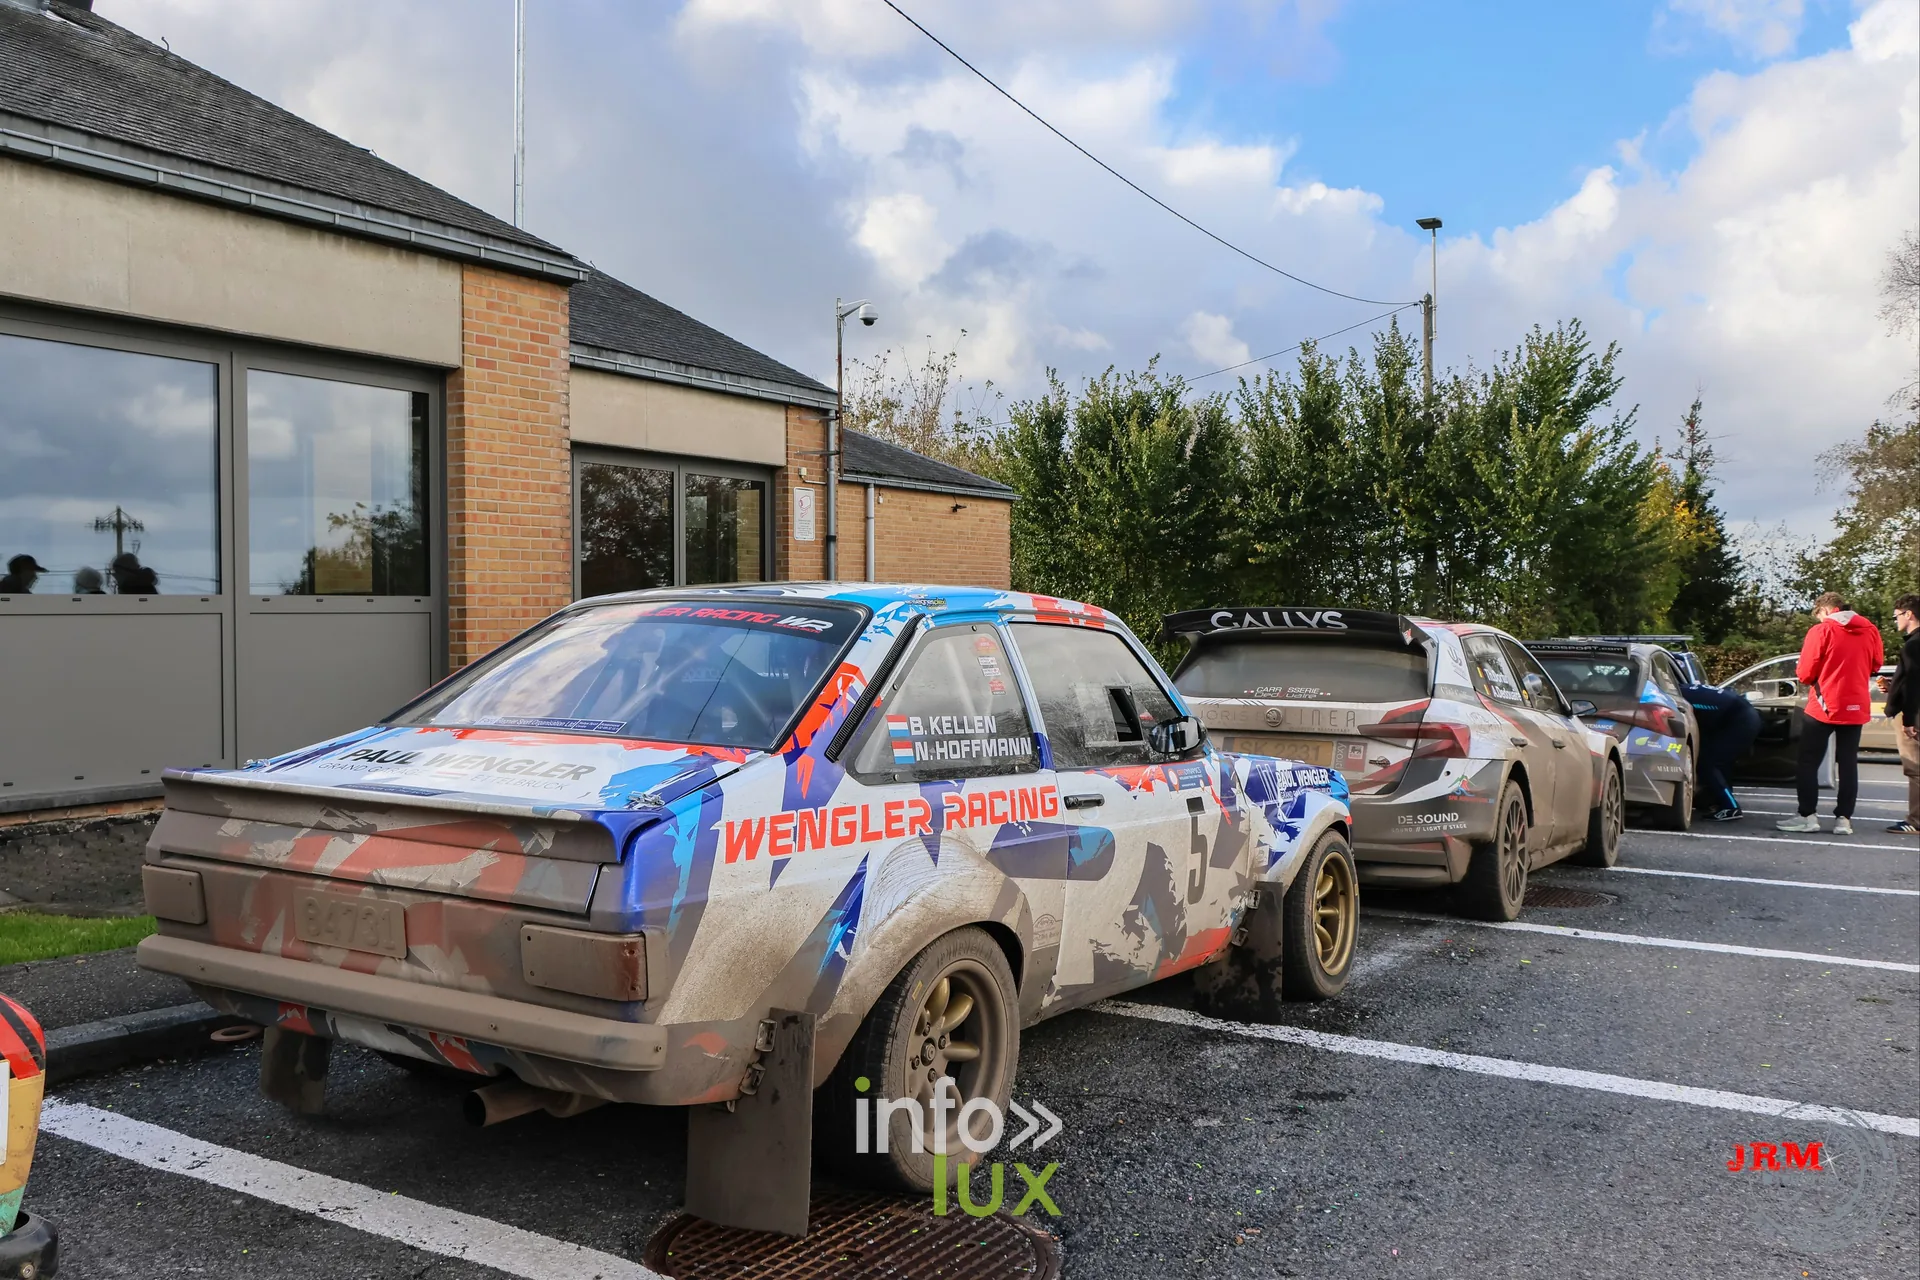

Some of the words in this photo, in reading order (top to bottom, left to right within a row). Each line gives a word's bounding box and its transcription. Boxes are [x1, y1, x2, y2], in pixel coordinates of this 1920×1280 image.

[688, 607, 781, 623] RACING
[776, 615, 834, 632] WR
[909, 716, 997, 736] B.KELLEN
[914, 737, 1032, 762] N.HOFFMANN
[1335, 743, 1346, 769] proxy
[318, 763, 368, 772] GRAND
[338, 748, 421, 765] PAUL
[422, 753, 597, 781] WENGLER
[1276, 770, 1297, 789] PAUL
[1295, 769, 1330, 786] WENGLER
[724, 799, 933, 864] WENGLER
[944, 785, 1060, 831] RACING
[1398, 813, 1459, 824] DE.SOUND
[1186, 797, 1208, 905] 5
